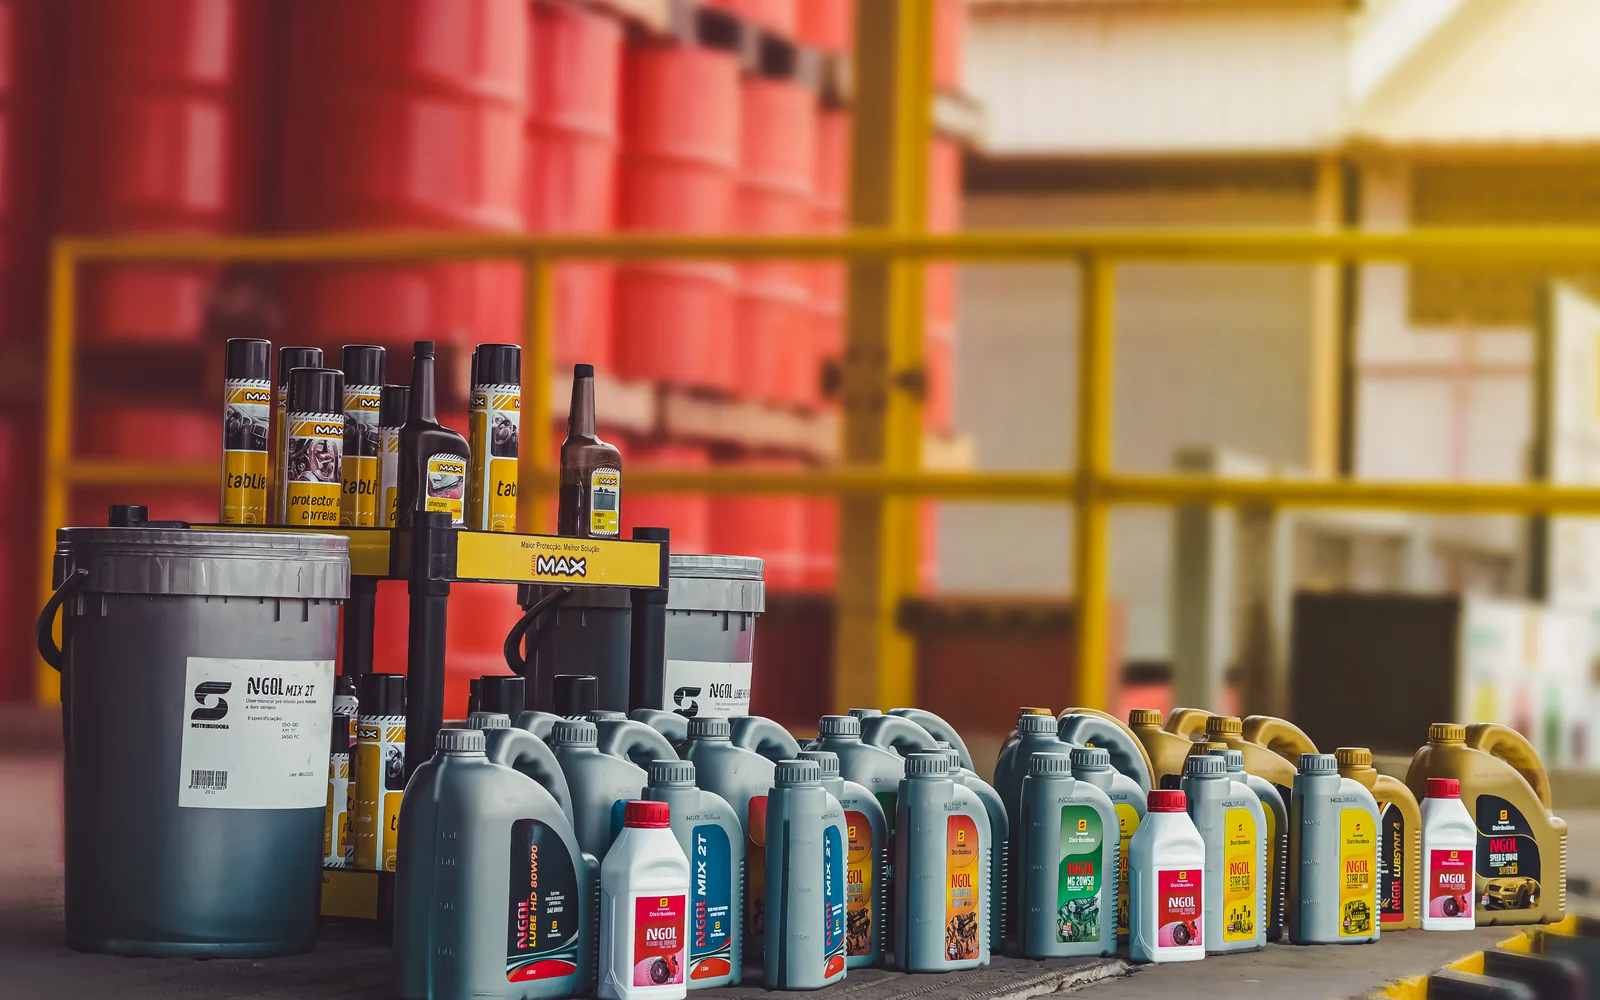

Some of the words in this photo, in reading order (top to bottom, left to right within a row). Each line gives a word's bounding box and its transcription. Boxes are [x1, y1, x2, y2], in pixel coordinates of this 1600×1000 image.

[439, 463, 462, 473] MAX
[599, 477, 617, 485] MAX
[291, 494, 334, 506] protector
[302, 510, 337, 521] correias
[521, 541, 535, 549] Maior
[563, 543, 579, 551] Melhor
[581, 544, 600, 554] Solução
[537, 554, 586, 577] MAX
[247, 676, 284, 695] NGOL
[285, 685, 303, 697] MIX
[304, 685, 314, 696] 2T
[709, 683, 732, 698] NGOL
[1393, 822, 1400, 830] 4
[697, 833, 707, 856] 2T
[825, 836, 831, 857] 2T
[1490, 837, 1518, 853] NGOL
[1393, 831, 1401, 877] LUBSYNT
[530, 845, 538, 888] 80W90
[1068, 862, 1094, 876] NGOL
[1230, 861, 1250, 875] NGOL
[1347, 860, 1368, 873] NGOL
[697, 860, 707, 896] MIX
[952, 873, 971, 888] NGOL
[1067, 876, 1075, 886] MG
[1076, 876, 1094, 886] 20W50
[1347, 874, 1358, 884] STAR
[1439, 873, 1466, 883] NGOL
[530, 891, 537, 911] HD
[1168, 896, 1195, 908] NGOL
[1391, 880, 1401, 910] NGOL
[517, 898, 529, 949] NGOL
[696, 898, 706, 947] NGOL
[529, 915, 537, 947] LUBE
[646, 927, 677, 941] NGOL
